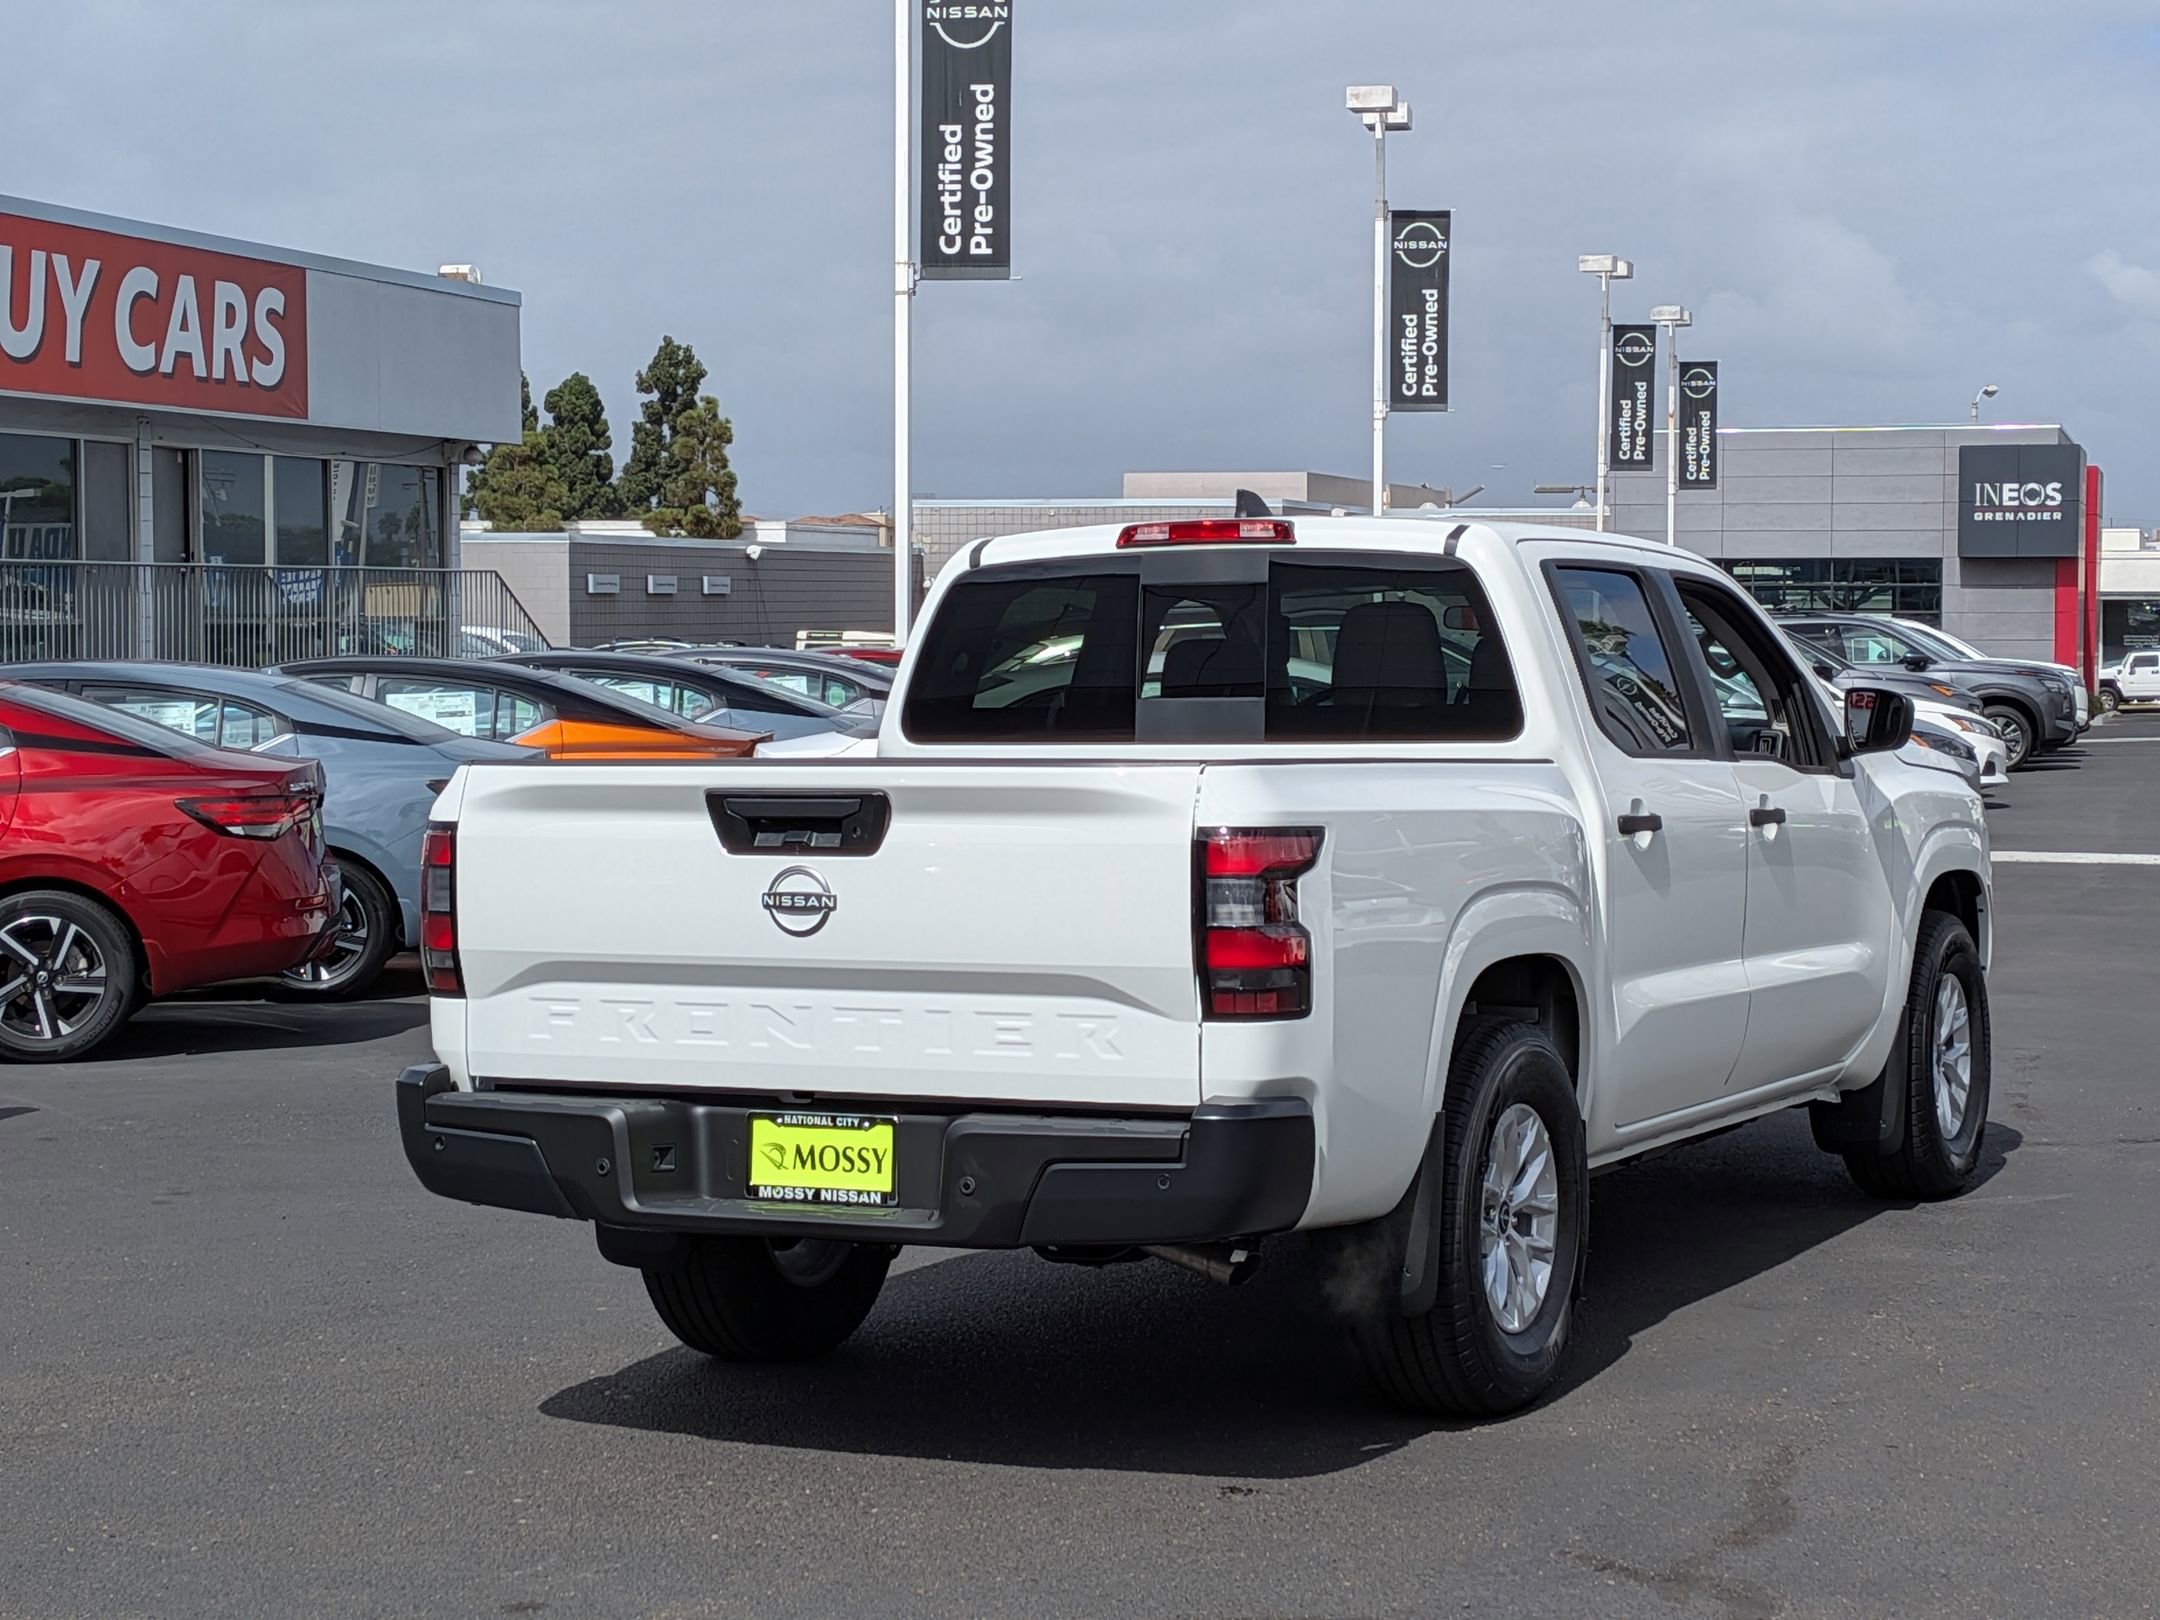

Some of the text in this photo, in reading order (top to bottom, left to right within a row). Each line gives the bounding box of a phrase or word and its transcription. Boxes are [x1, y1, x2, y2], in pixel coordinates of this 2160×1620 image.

[926, 6, 1008, 19] NISSAN
[938, 124, 962, 255] Certified
[970, 84, 994, 255] Pre-Owned
[1393, 241, 1448, 249] NISSAN
[115, 265, 287, 387] CARS
[1422, 288, 1438, 396] Pre-Owned
[1402, 314, 1417, 396] Certified
[1619, 400, 1632, 460] Certified
[1634, 381, 1648, 460] Pre-Owned
[1699, 411, 1711, 480] Pre-Owned
[1686, 427, 1697, 480] Certified
[1973, 512, 2063, 521] GRENADIER
[1974, 482, 2063, 507] INEOS
[763, 894, 835, 908] NISSAN
[528, 996, 1125, 1061] FRONTIER
[783, 1115, 860, 1128] NATIONAL CITY
[793, 1143, 888, 1175] MOSSY
[758, 1185, 882, 1205] MOSSY NISSAN
